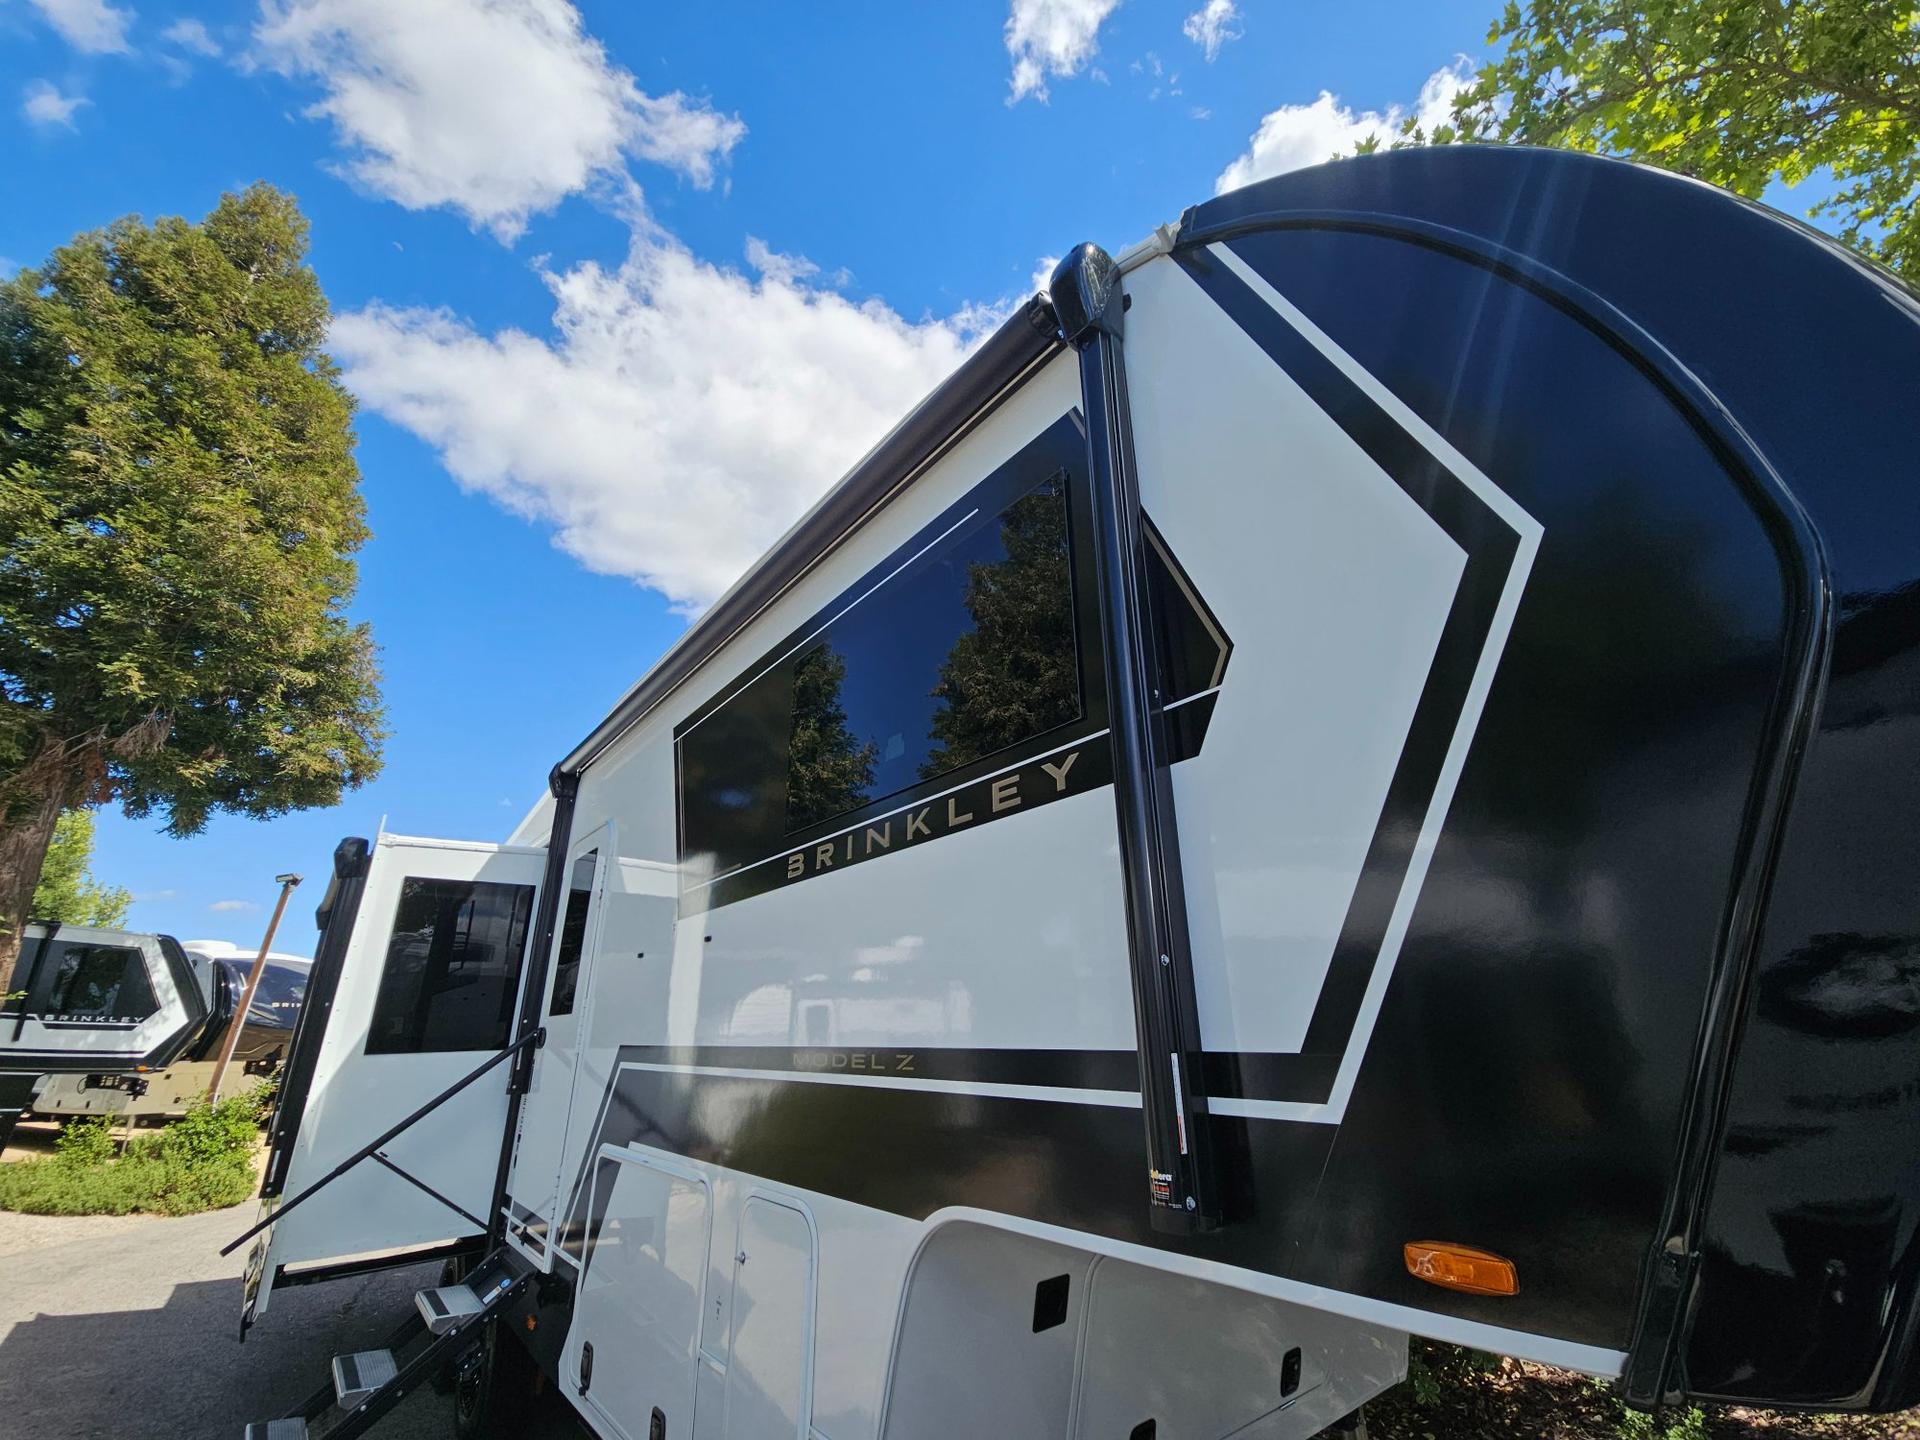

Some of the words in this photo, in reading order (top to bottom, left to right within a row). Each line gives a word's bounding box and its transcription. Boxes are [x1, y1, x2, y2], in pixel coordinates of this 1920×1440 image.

[788, 752, 1080, 879] BRINKLEY
[44, 1014, 143, 1023] BRINKLEY
[793, 1053, 886, 1070] MODEL
[895, 1054, 915, 1071] Z
